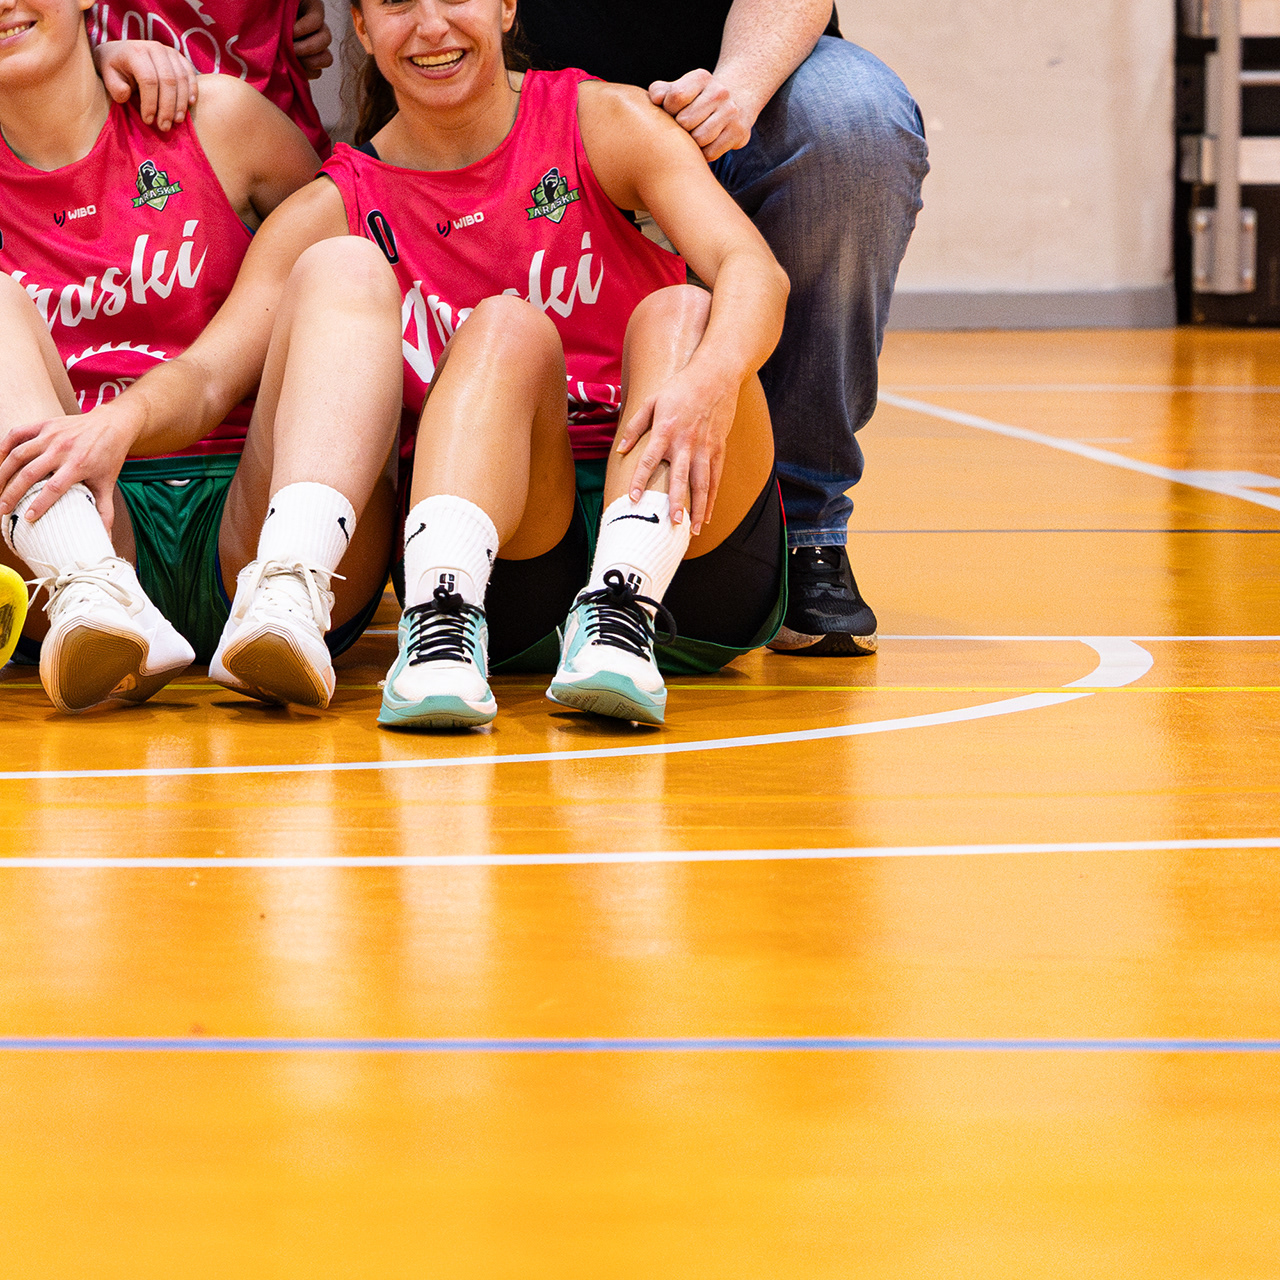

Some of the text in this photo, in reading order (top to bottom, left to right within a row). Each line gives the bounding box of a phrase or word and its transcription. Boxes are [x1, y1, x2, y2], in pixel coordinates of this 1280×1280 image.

[138, 186, 176, 205] ARASKI
[534, 192, 576, 216] ARASKI
[67, 204, 97, 220] WIBO
[453, 211, 485, 230] WIBO
[11, 220, 209, 333] raski
